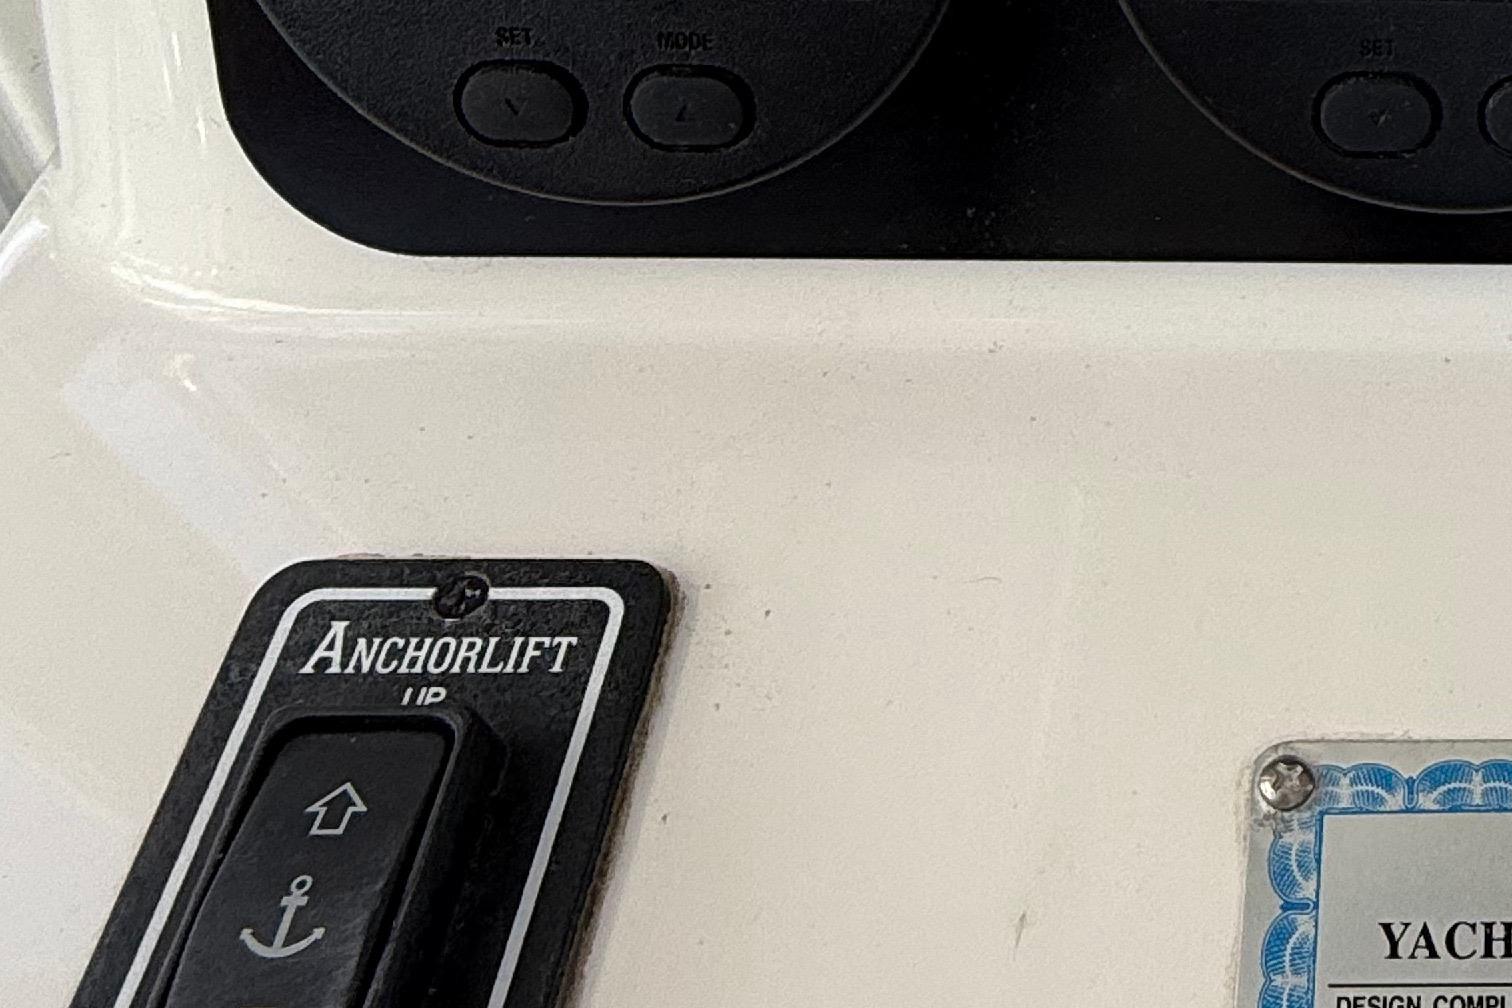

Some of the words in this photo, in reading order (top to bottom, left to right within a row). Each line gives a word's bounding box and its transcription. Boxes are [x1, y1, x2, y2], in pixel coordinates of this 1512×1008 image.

[494, 26, 534, 47] SET
[656, 31, 713, 51] MODE
[1358, 38, 1396, 57] SET
[1336, 994, 1422, 1008] DESIGN
